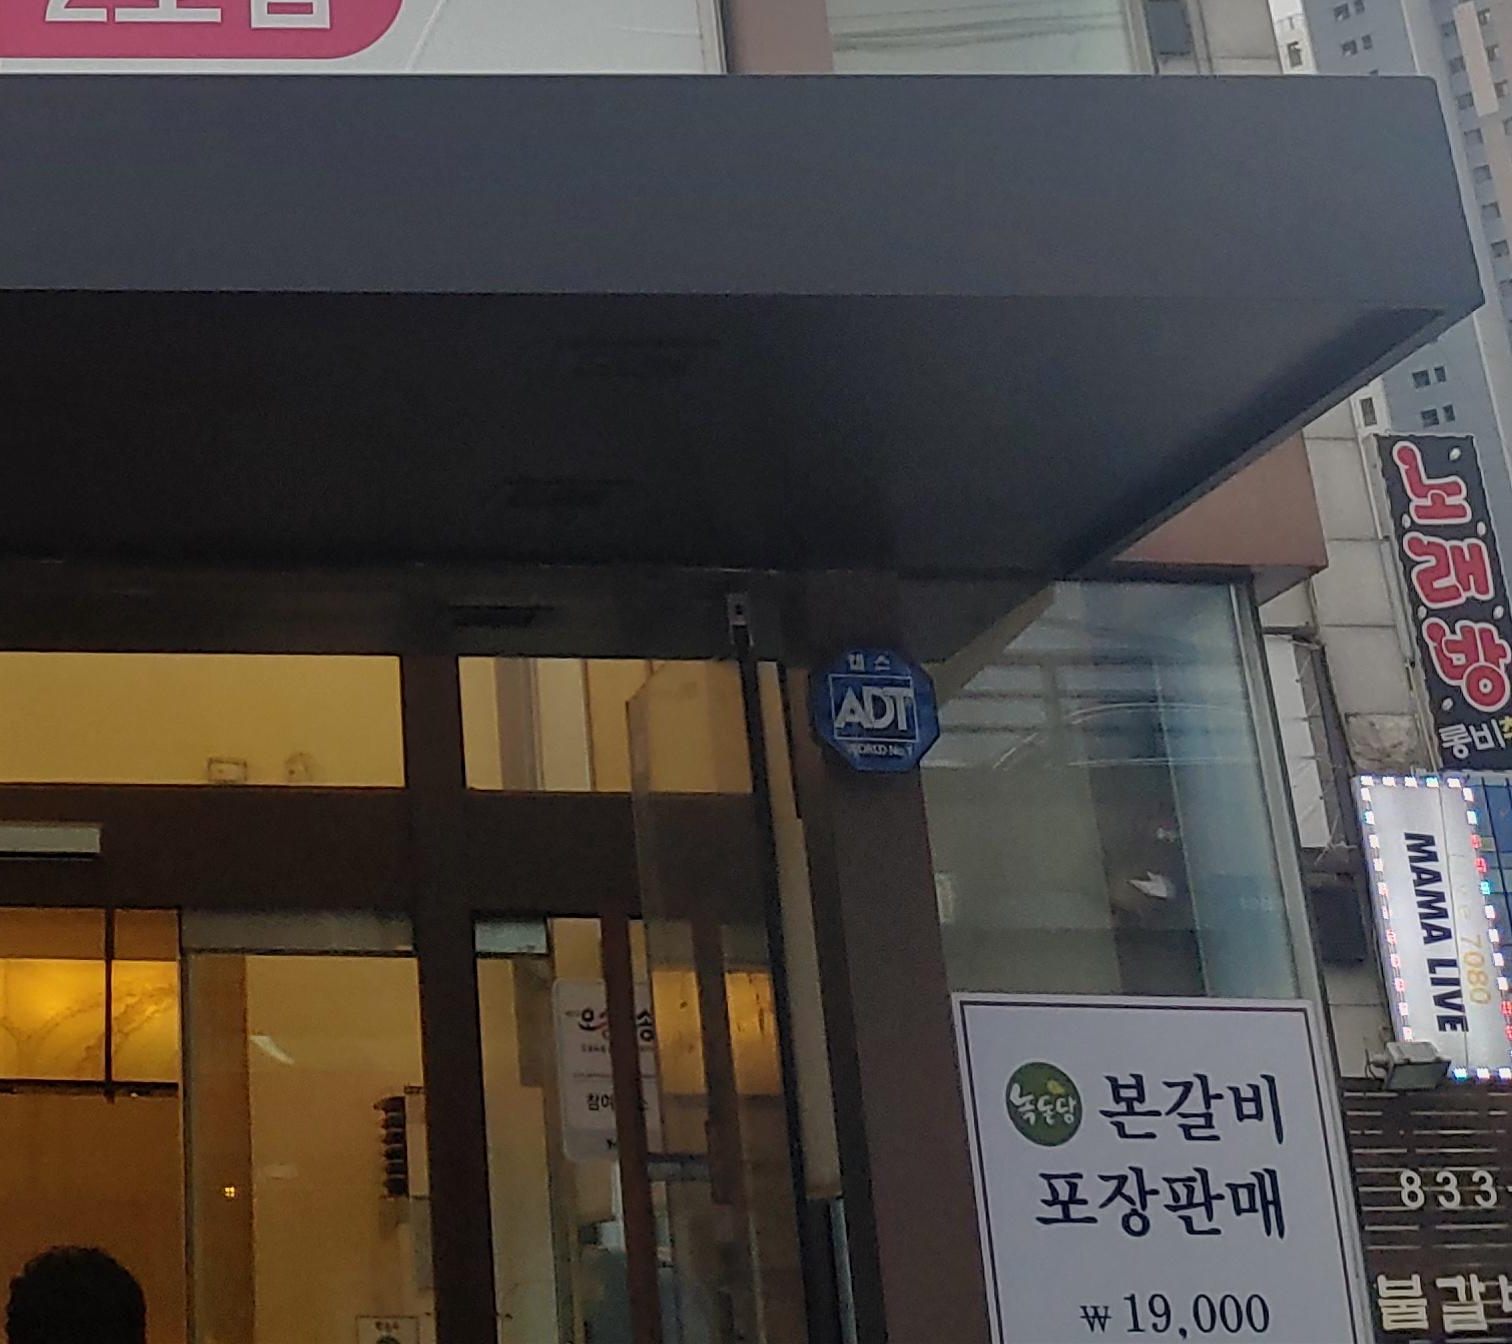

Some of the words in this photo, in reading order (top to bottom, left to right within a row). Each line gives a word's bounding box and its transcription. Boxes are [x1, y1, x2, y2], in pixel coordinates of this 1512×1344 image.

[1392, 440, 1511, 712] 노래방
[834, 686, 914, 731] ADT
[1404, 832, 1453, 945] MAMA
[1426, 958, 1469, 1033] LIVE
[1461, 934, 1492, 1005] 7080
[1099, 1073, 1284, 1145] 본갈비
[1035, 1166, 1285, 1239] 포장판매
[1399, 1168, 1512, 1209] 833
